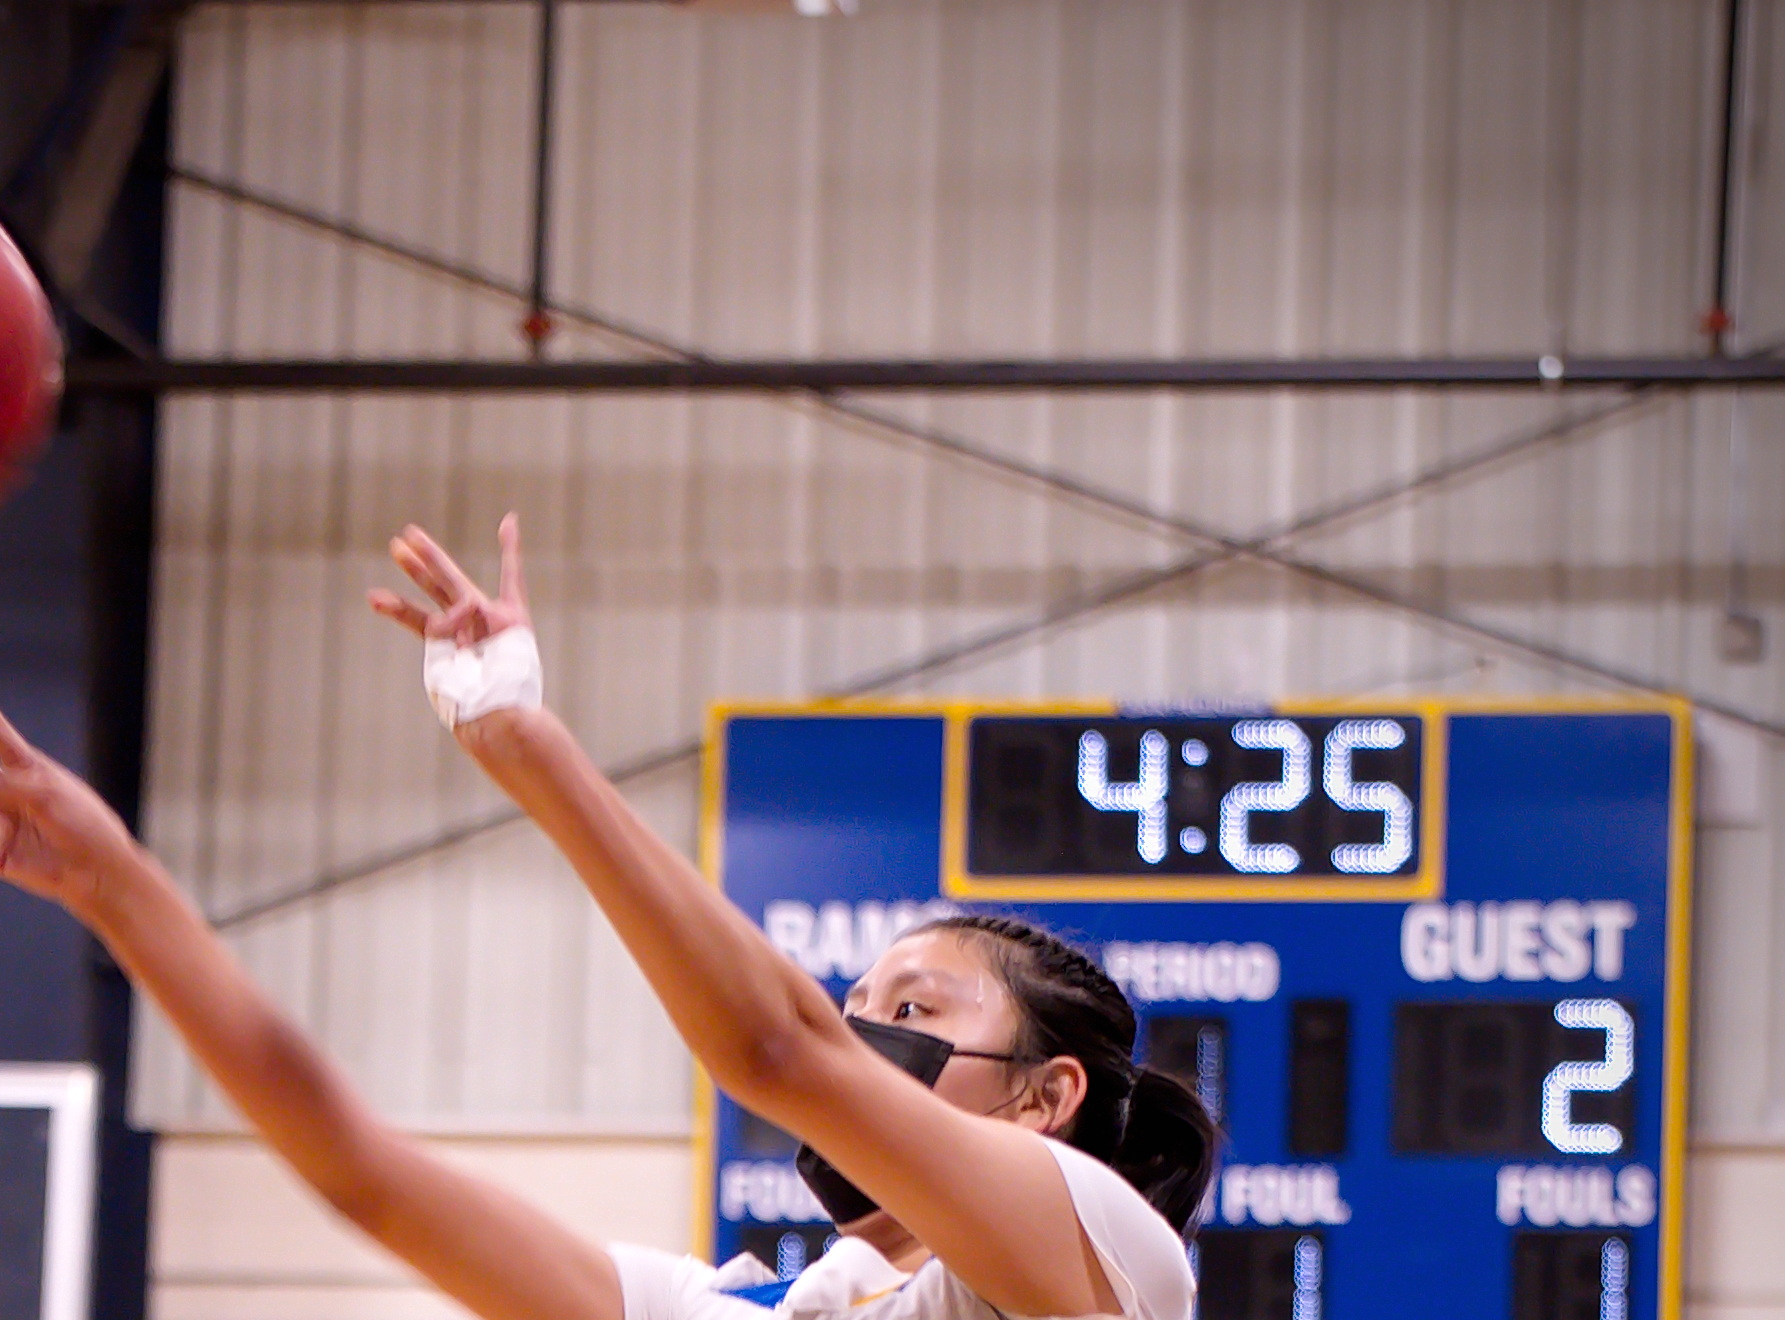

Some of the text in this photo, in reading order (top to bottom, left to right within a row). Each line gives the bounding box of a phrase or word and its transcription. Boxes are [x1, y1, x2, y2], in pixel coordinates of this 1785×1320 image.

[1078, 719, 1414, 873] 4:25
[1104, 942, 1281, 1001] PERIOD
[1400, 899, 1636, 983] GUEST
[1543, 998, 1634, 1154] 2
[1221, 1163, 1353, 1227] FOUL
[1496, 1164, 1658, 1227] FOULS
